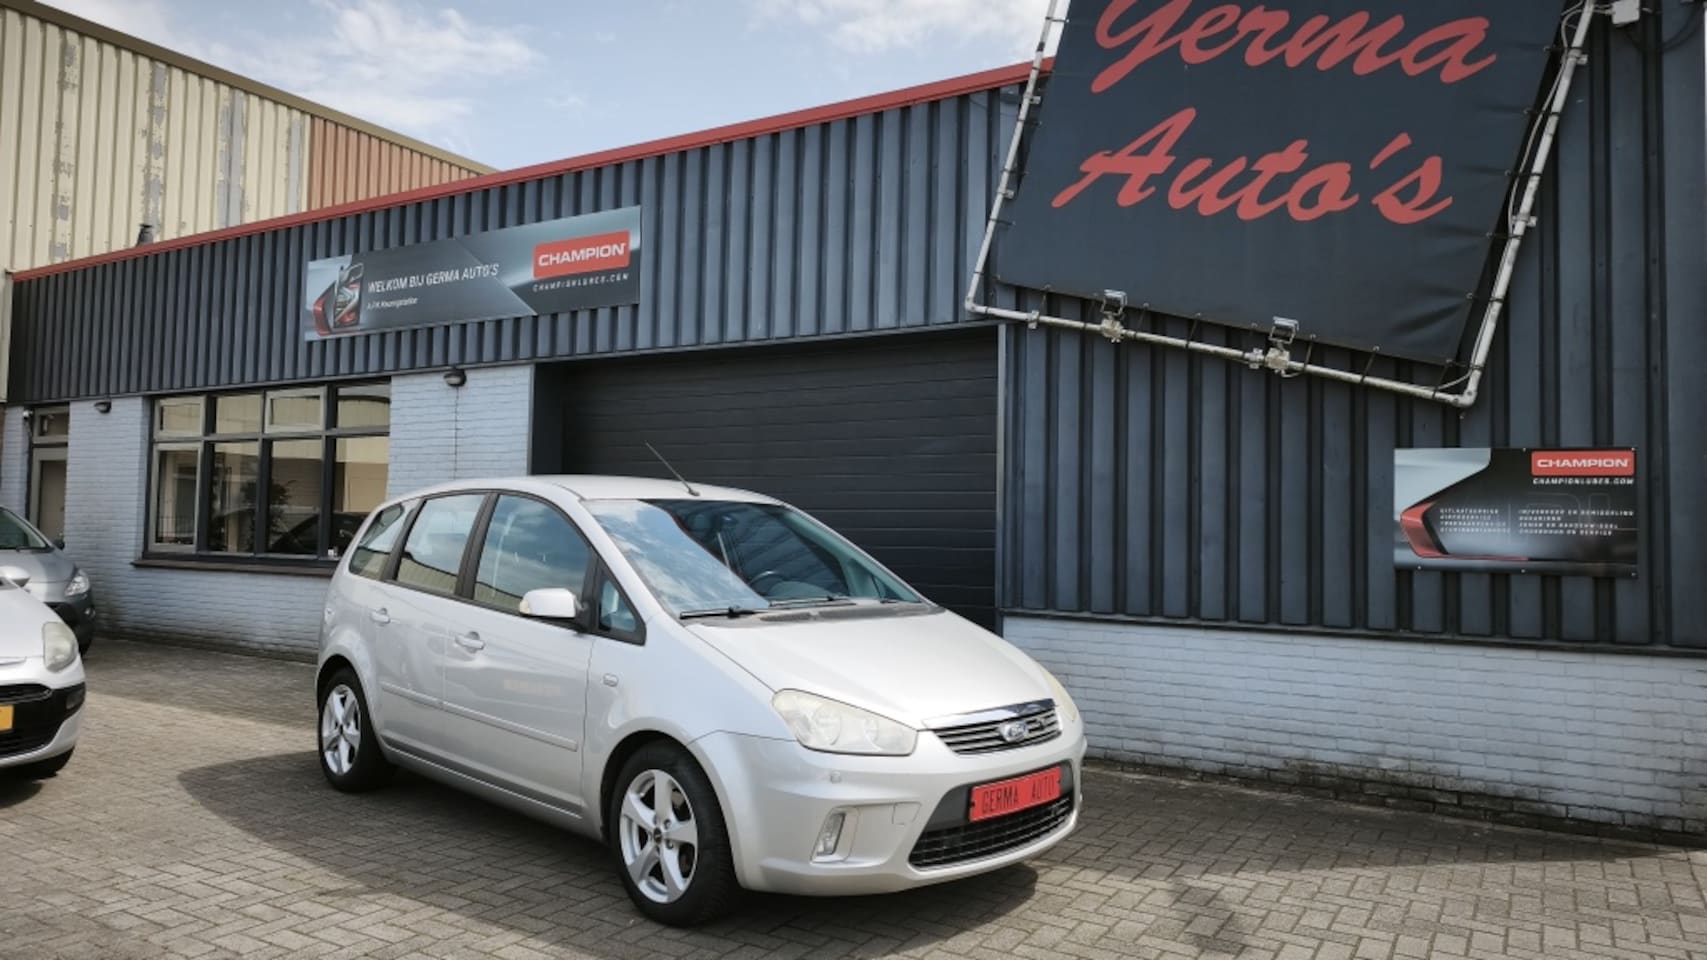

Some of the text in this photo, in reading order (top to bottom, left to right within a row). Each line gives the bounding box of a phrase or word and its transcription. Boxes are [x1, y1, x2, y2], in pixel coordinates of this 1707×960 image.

[1052, 107, 1453, 223] Auto's
[538, 242, 626, 267] CHAMPION
[367, 277, 408, 293] WELKOM
[426, 269, 460, 286] GERMA
[461, 263, 500, 281] AUTO'S
[1536, 458, 1629, 468] CHAMPION
